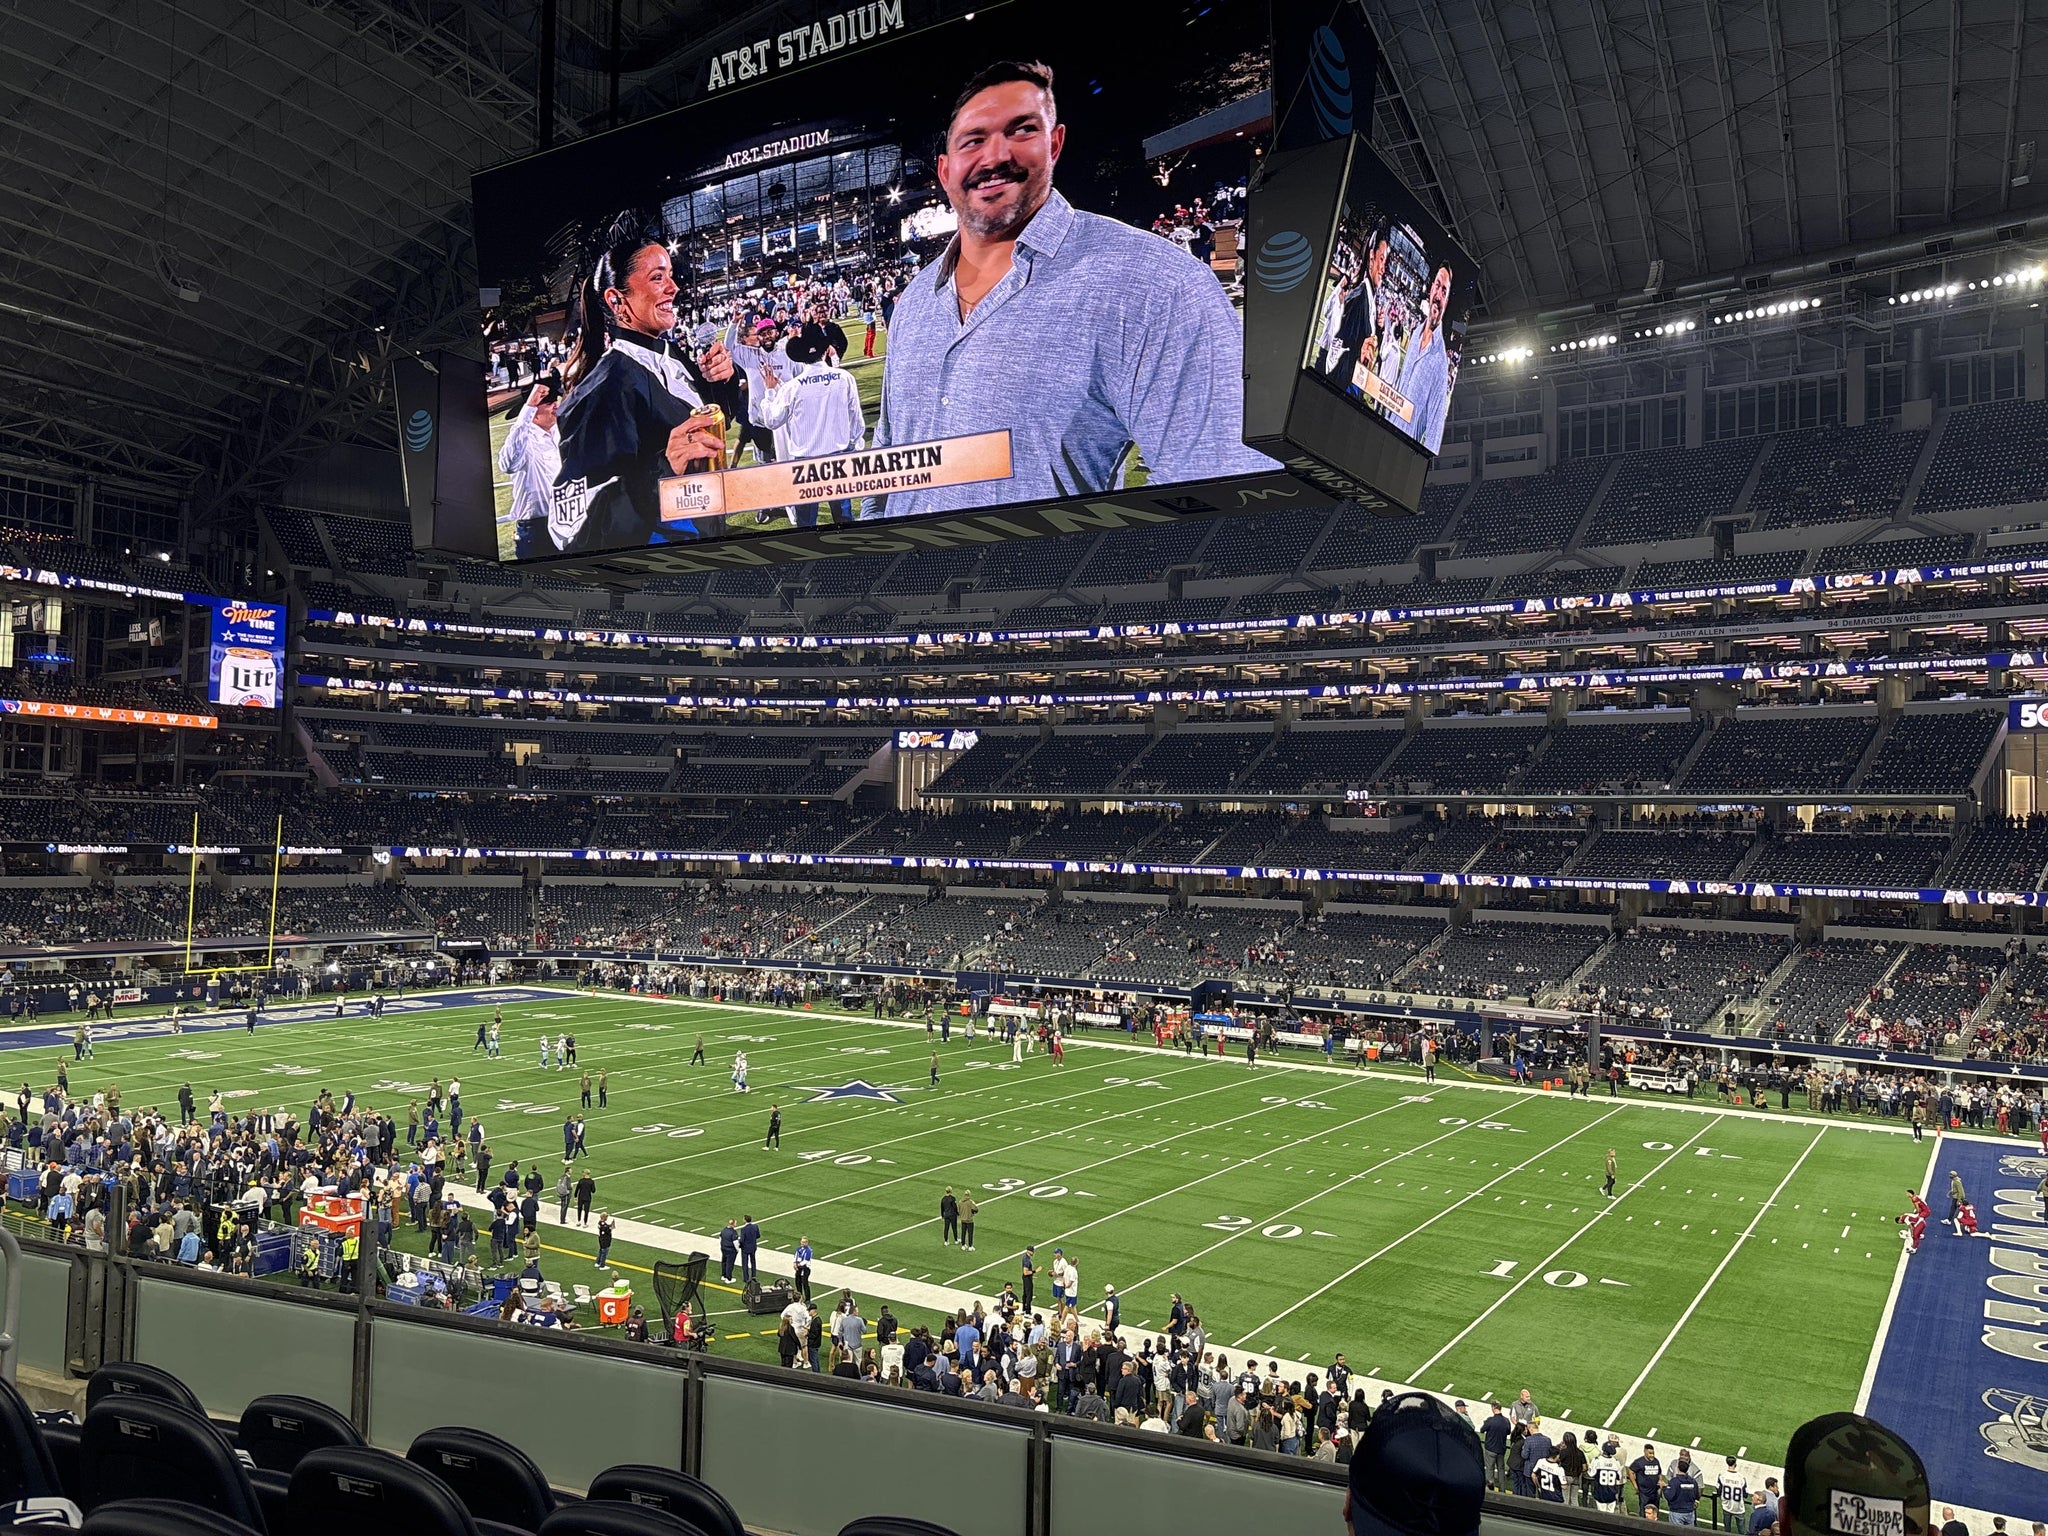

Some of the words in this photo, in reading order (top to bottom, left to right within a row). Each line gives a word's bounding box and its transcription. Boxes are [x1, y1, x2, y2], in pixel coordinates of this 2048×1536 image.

[708, 39, 770, 91] AT&T
[778, 0, 904, 68] STADIUM
[724, 147, 760, 169] AT&T
[762, 128, 829, 158] STADIUM
[798, 372, 841, 386] Wrangler
[792, 459, 846, 485] ZACK
[850, 445, 942, 479] MARTIN
[683, 483, 702, 497] Lite
[800, 484, 832, 500] 2010'S
[836, 477, 898, 496] ALL-DECADE
[900, 472, 932, 488] TEAM
[1284, 456, 1388, 509] WINSTAR
[676, 494, 710, 509] House
[558, 498, 585, 522] NFL
[646, 500, 1178, 573] WINSTAR
[1950, 567, 1968, 576] THE
[1987, 564, 2013, 573] BEER
[2015, 562, 2027, 570] OF
[2030, 560, 2048, 568] THE
[1835, 576, 1852, 588] 50
[80, 580, 94, 589] THE
[108, 584, 126, 593] BEER
[127, 586, 136, 594] OF
[137, 588, 151, 596] THE
[152, 590, 183, 601] COWBOYS
[1685, 590, 1706, 598] BEER
[1719, 587, 1735, 596] THE
[1737, 584, 1776, 594] COWBOYS
[232, 600, 247, 609] IT'S
[1466, 606, 1480, 614] THE
[1481, 604, 1513, 613] COWBOYS
[222, 607, 276, 624] Miller
[1259, 619, 1288, 627] COWBOYS
[1894, 615, 1922, 623] WARE
[129, 623, 141, 632] LESS
[250, 620, 275, 630] TIME
[1670, 630, 1696, 638] LARRY
[1698, 628, 1724, 636] ALLEN
[129, 631, 148, 642] FILLING
[1898, 661, 1919, 669] BEER
[1932, 660, 1947, 668] THE
[1949, 658, 1987, 667] COWBOYS
[230, 666, 274, 692] Lite
[2020, 704, 2048, 728] 50
[899, 732, 920, 748] 50
[58, 845, 128, 853] Blockchain.com
[178, 846, 240, 854] Blockchain.com
[287, 846, 342, 854] Blockchain.com
[374, 852, 390, 864] 40
[1575, 880, 1592, 888] BEER
[1603, 881, 1616, 889] THE
[1617, 882, 1649, 890] COWBOYS
[1797, 888, 1812, 896] THE
[1828, 889, 1849, 897] BEER
[1850, 890, 1861, 898] OF
[1863, 890, 1878, 898] THE
[1880, 891, 1919, 900] COWBOYS
[1988, 893, 2005, 904] 50
[631, 1123, 704, 1139] 50
[797, 1149, 872, 1166] 40
[981, 1178, 1068, 1198] 30
[1201, 1214, 1303, 1239] 20
[1478, 1259, 1589, 1288] 10
[603, 1302, 616, 1316] G
[1540, 1470, 1555, 1492] 21
[1599, 1470, 1616, 1486] 88
[1723, 1486, 1741, 1502] 88
[1851, 1496, 1902, 1534] BUBBA
[1840, 1514, 1889, 1536] WESTLY
